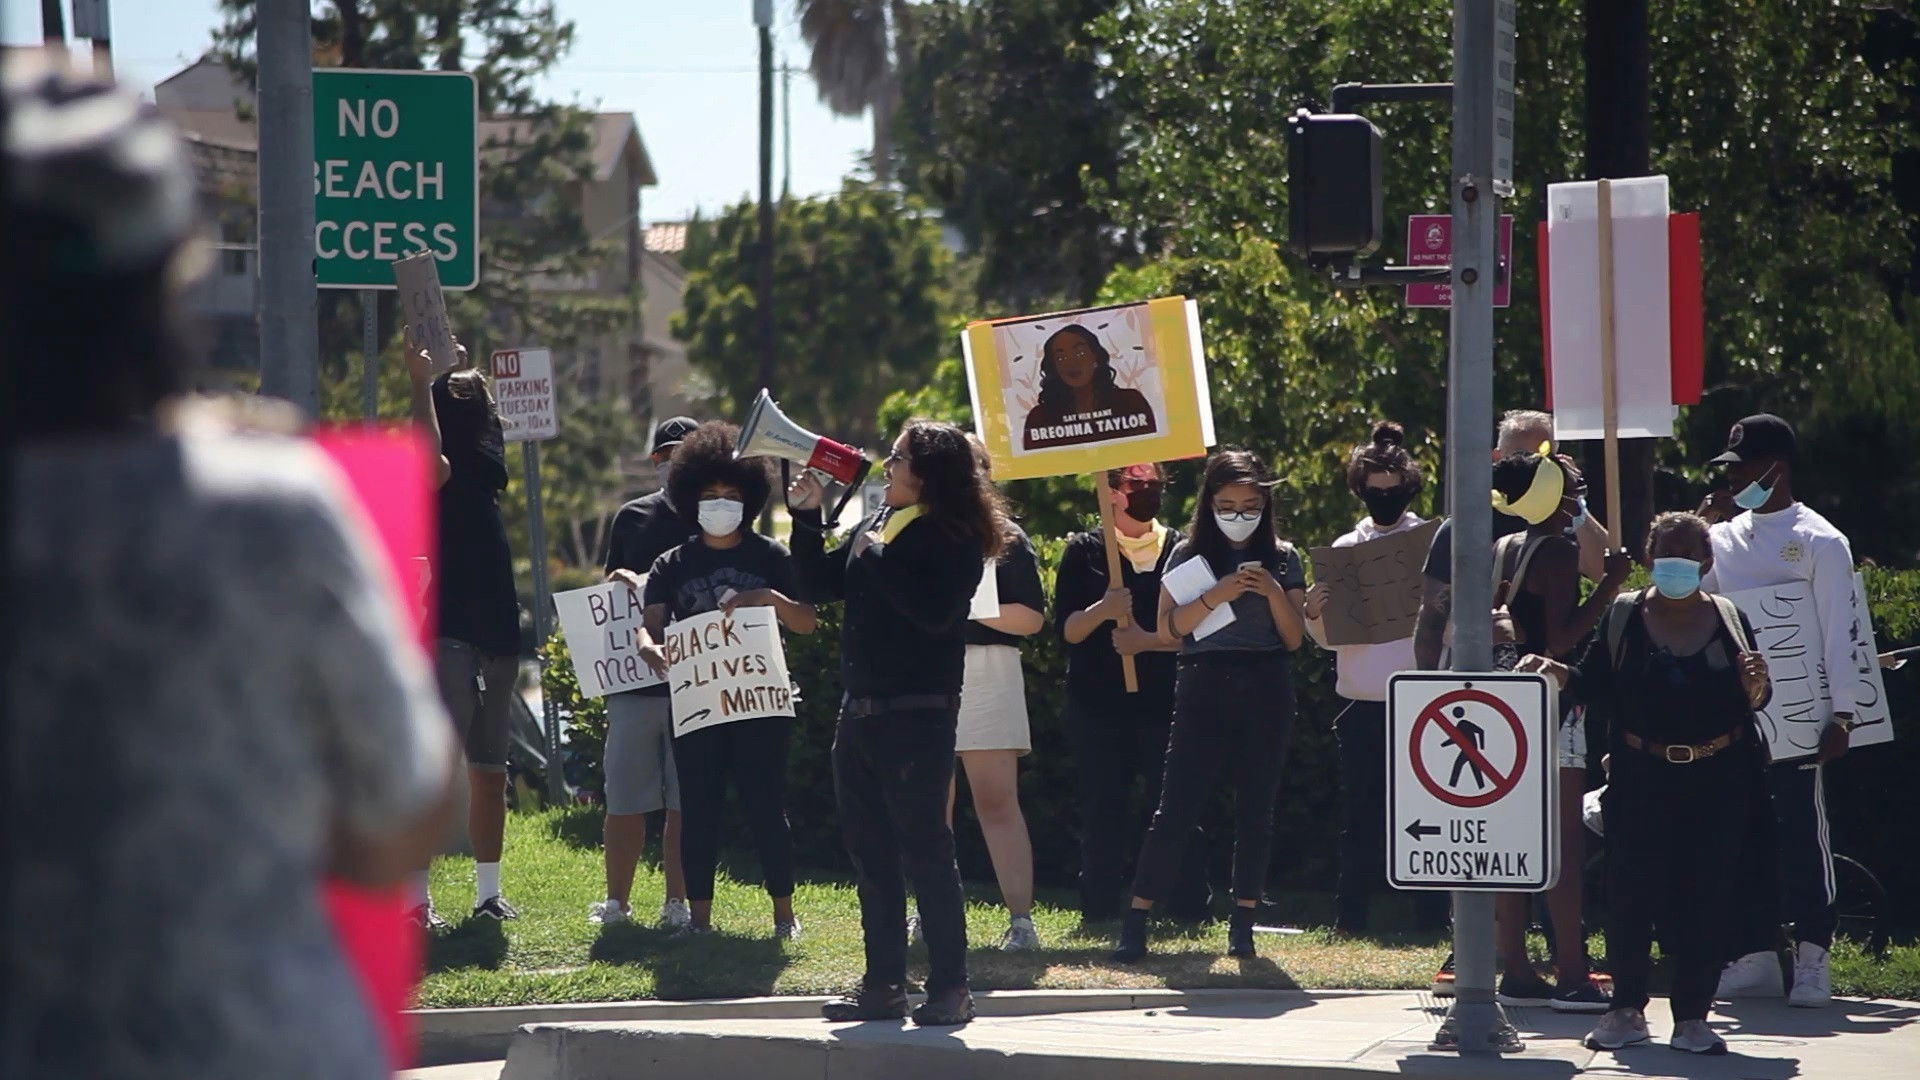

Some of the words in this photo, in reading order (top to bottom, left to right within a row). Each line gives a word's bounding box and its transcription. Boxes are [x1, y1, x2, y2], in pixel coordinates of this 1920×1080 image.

[337, 98, 400, 138] NO
[315, 220, 459, 262] CCESS
[496, 353, 518, 375] NO
[500, 378, 550, 398] PARKING
[500, 398, 550, 415] TUESDAY
[1062, 414, 1077, 423] SAY
[1079, 412, 1092, 421] HER
[1092, 408, 1113, 419] NAME
[1030, 422, 1093, 441] BREONNA
[1095, 413, 1148, 432] TAYLOR
[588, 588, 645, 626] BLA
[666, 618, 742, 666] BLACK
[694, 654, 767, 687] LIVES
[1759, 590, 1821, 751] CALLING
[721, 686, 792, 716] MATTER
[1450, 819, 1488, 844] USE
[1409, 850, 1529, 877] CROSSWALK
